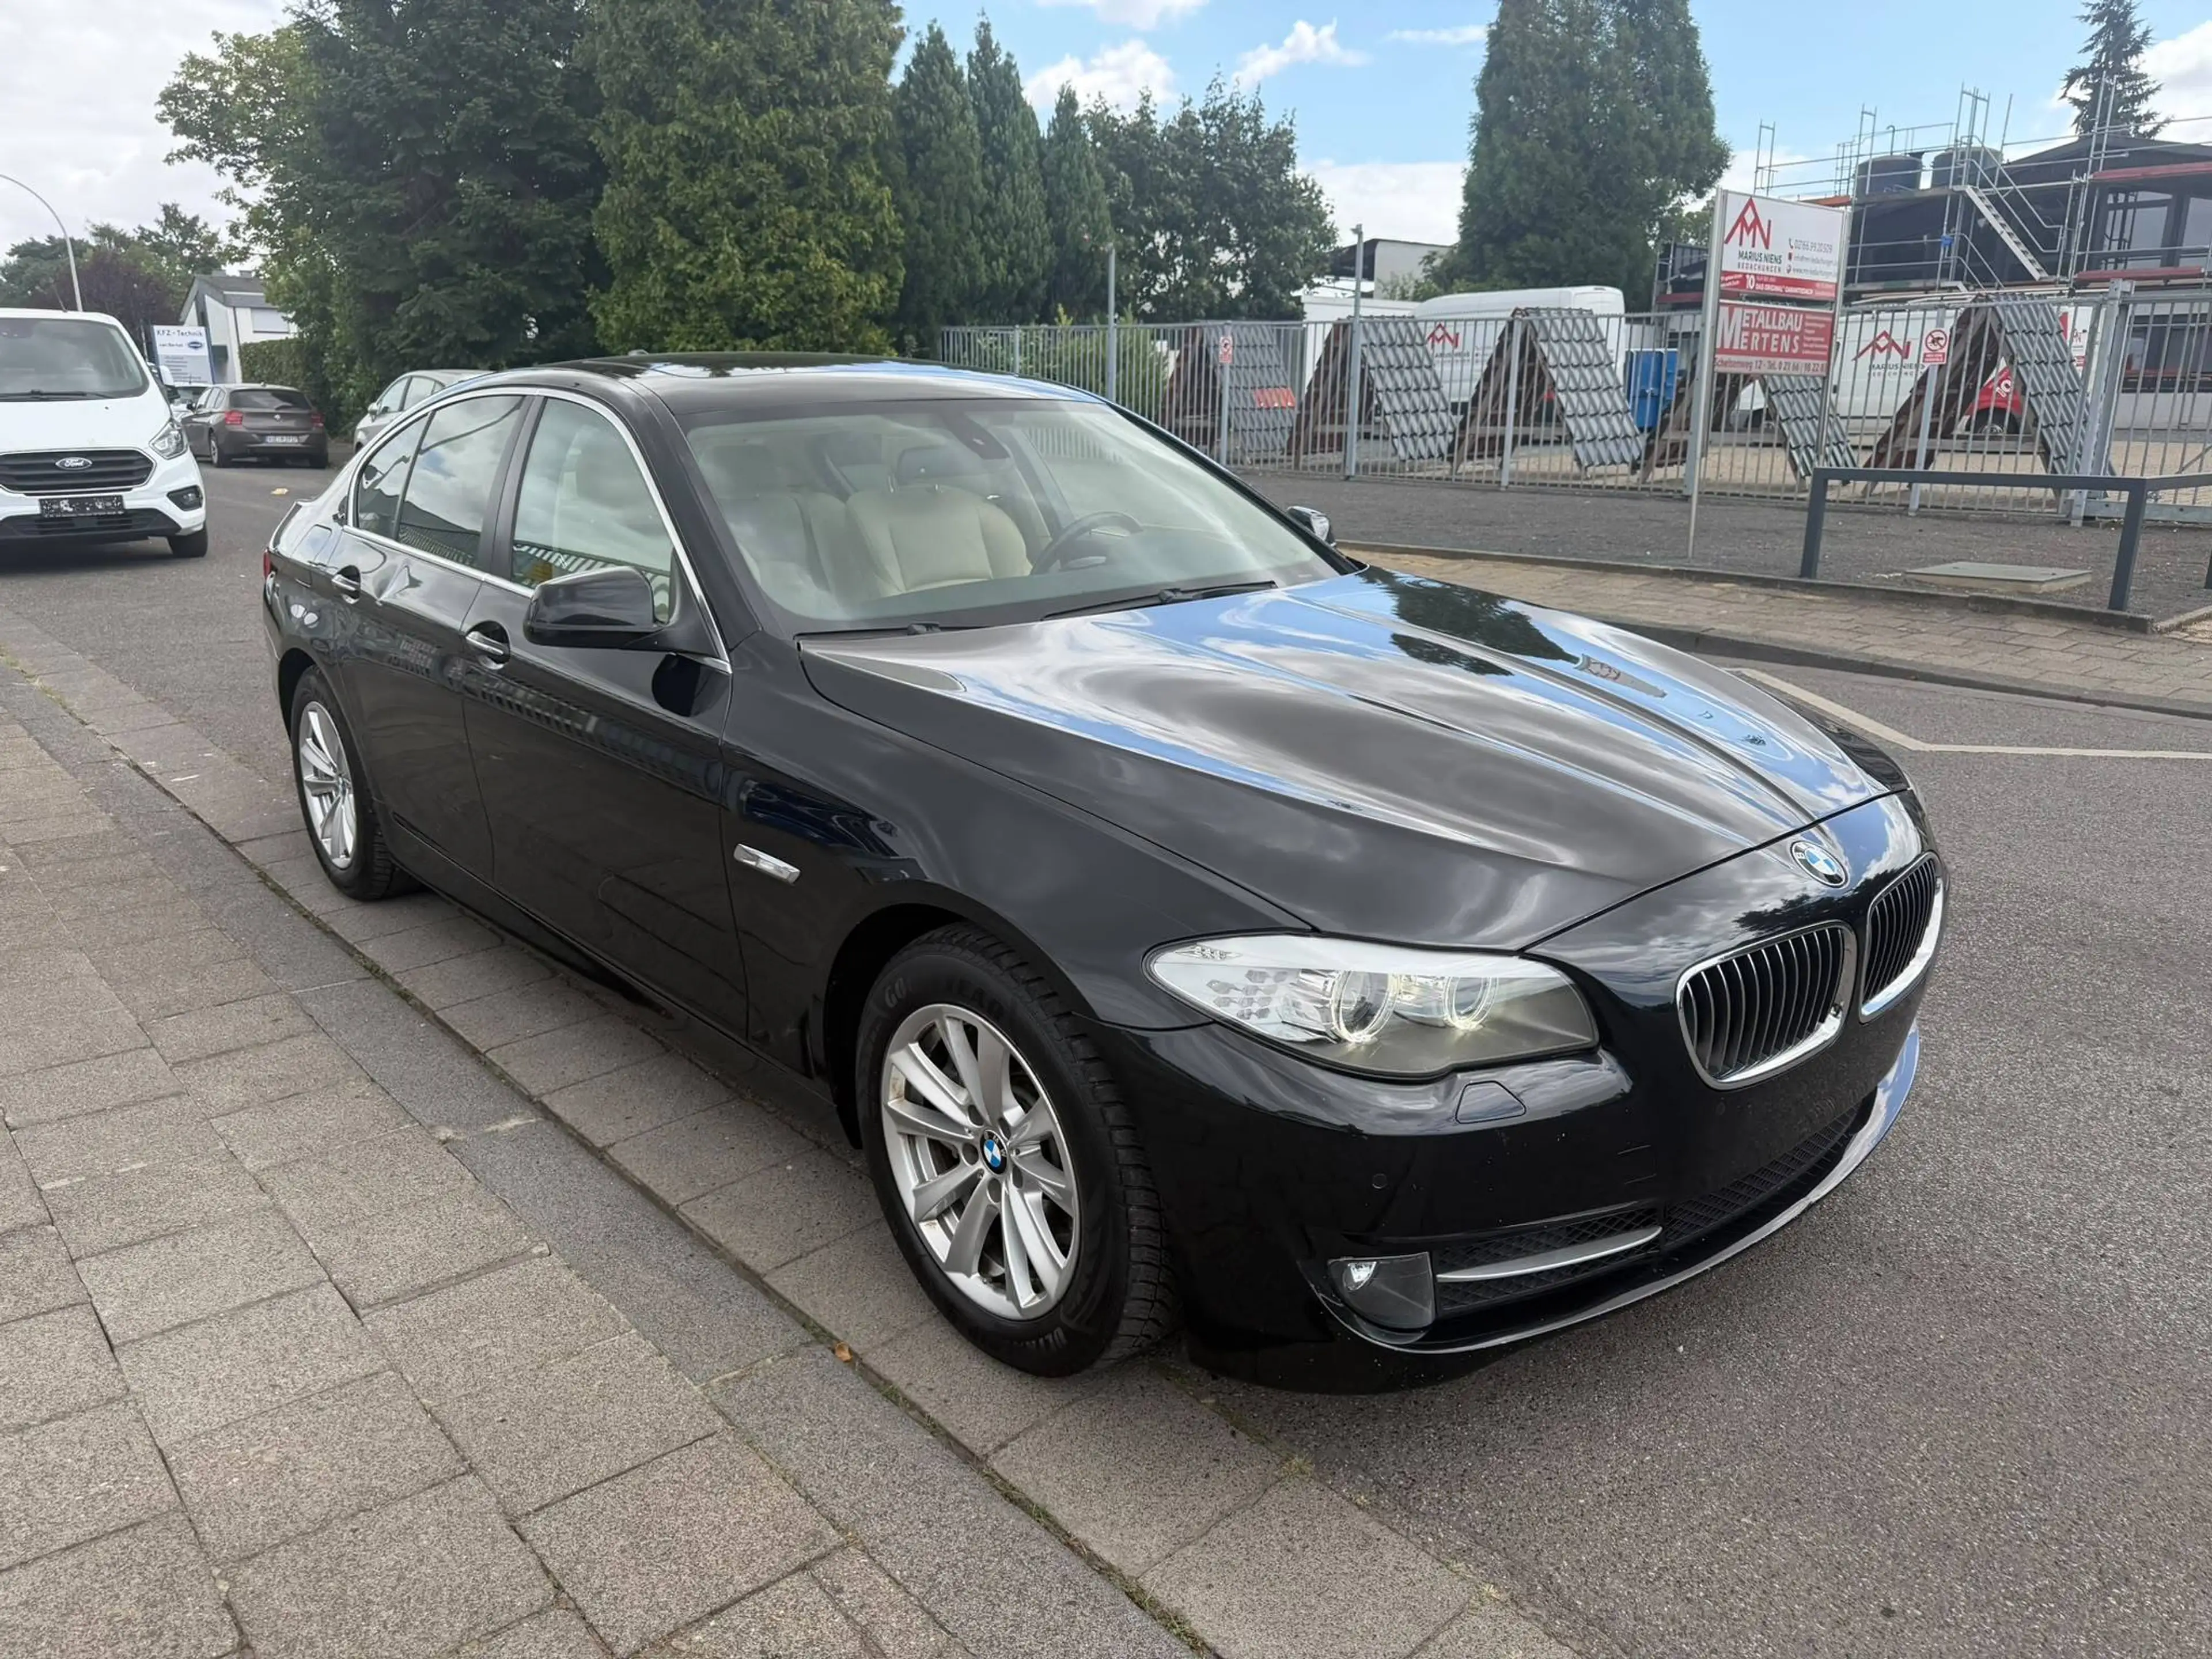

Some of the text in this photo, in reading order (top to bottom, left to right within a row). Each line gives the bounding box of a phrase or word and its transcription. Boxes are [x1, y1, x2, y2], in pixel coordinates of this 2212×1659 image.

[1738, 250, 1763, 263] MARIUS
[1763, 252, 1783, 264] NIENS
[1737, 262, 1782, 274] BEDACHUNGEN
[1746, 274, 1756, 290] 10
[1716, 306, 1804, 347] METALLBAU
